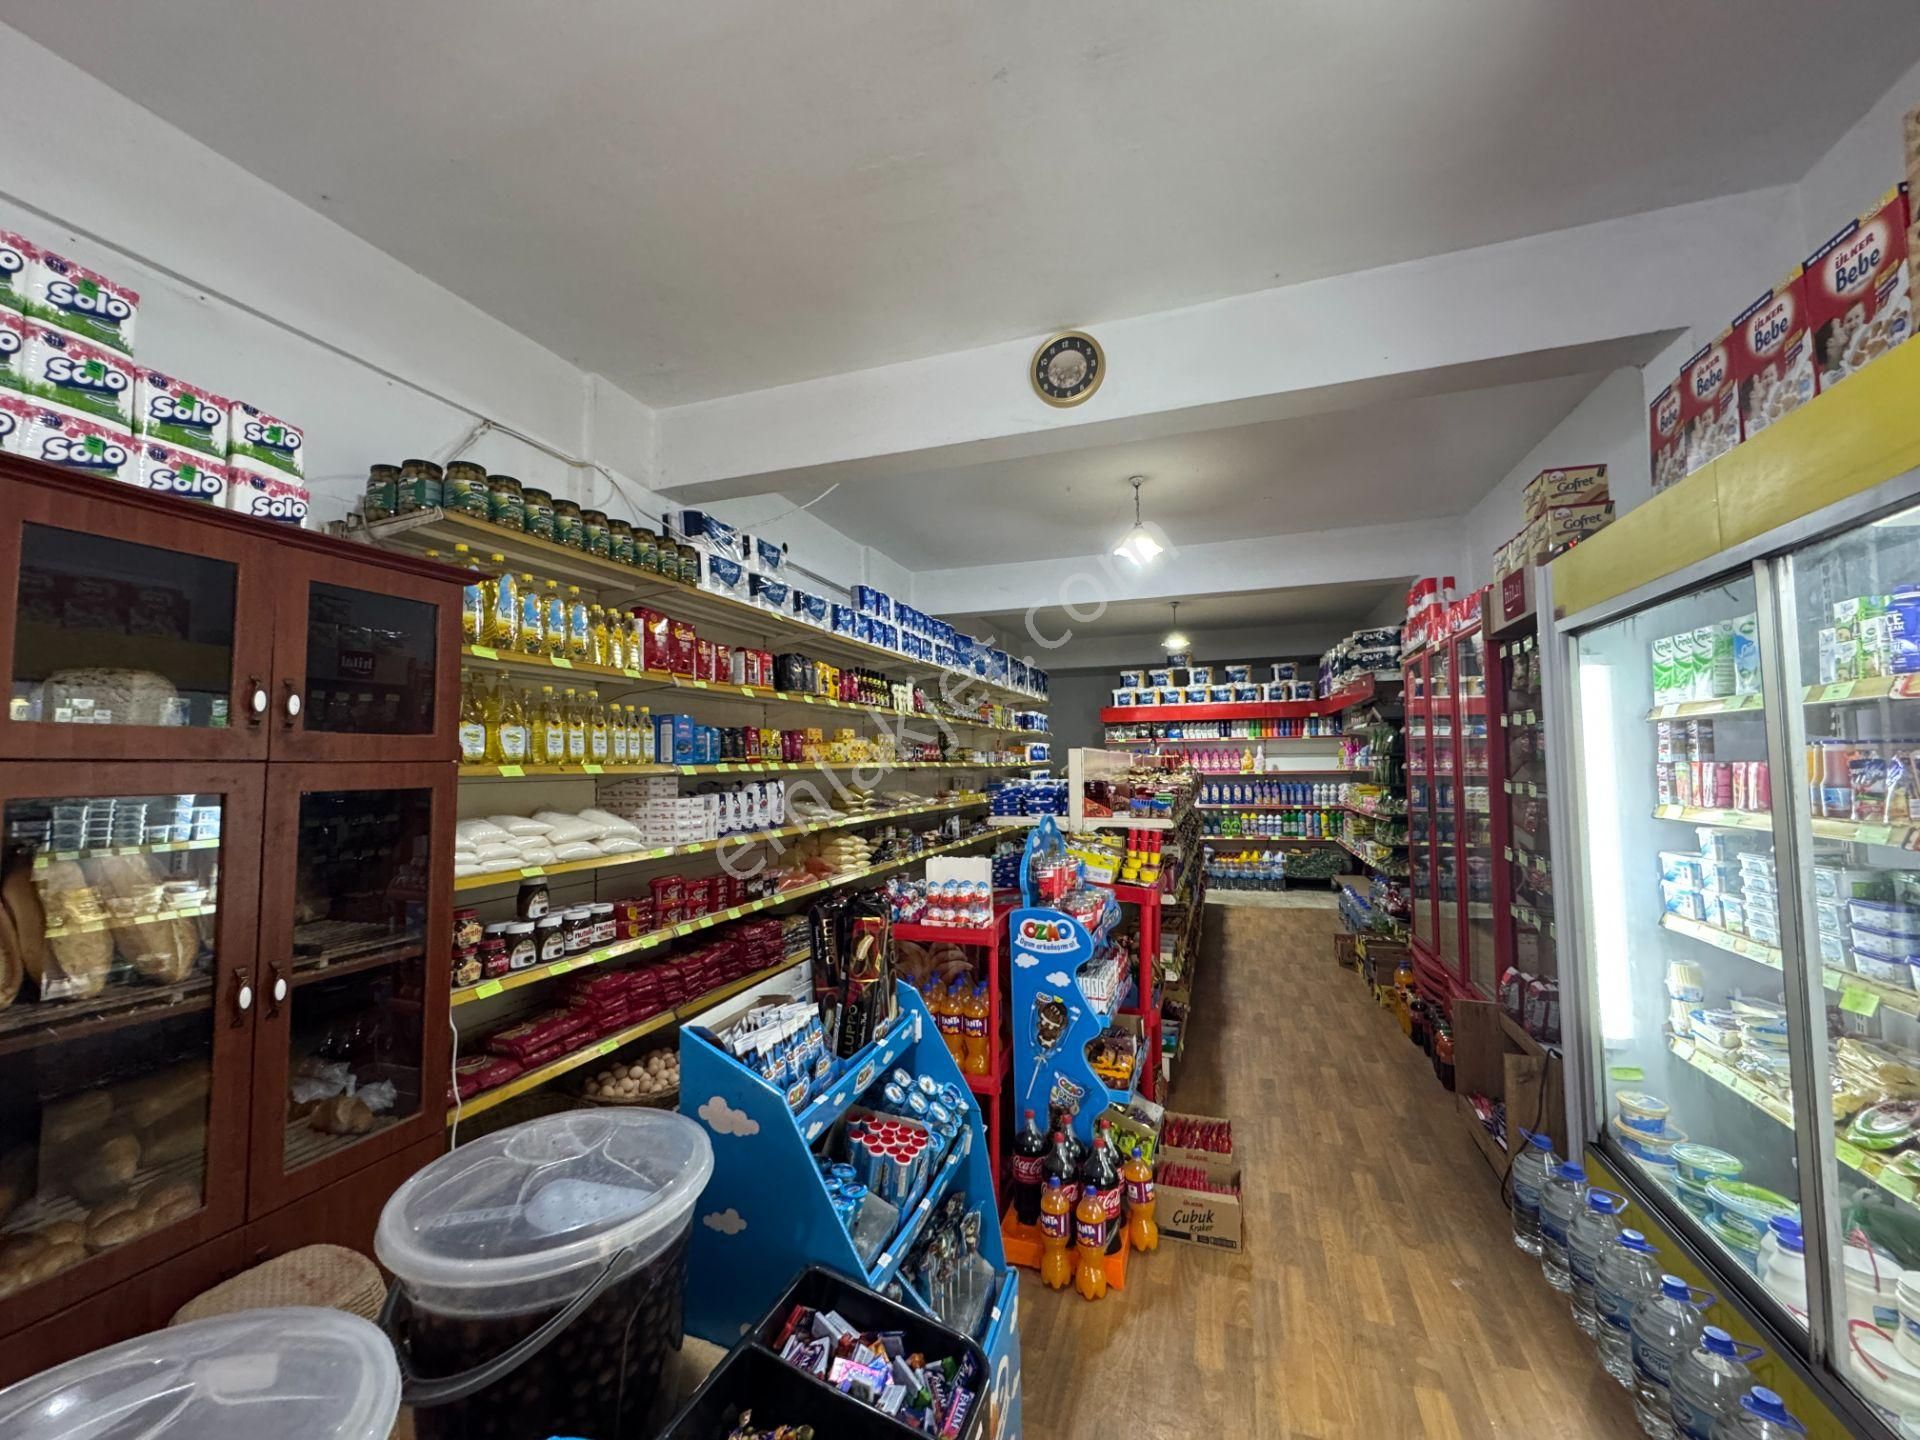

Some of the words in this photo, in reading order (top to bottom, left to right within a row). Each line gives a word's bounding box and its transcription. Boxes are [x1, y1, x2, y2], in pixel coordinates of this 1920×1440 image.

[1836, 248, 1880, 292] Bebe
[46, 281, 131, 320] Solo
[1755, 317, 1788, 352] Bebe
[1696, 368, 1722, 396] Bebe
[150, 396, 221, 427] Solo
[150, 469, 222, 497] Solo
[1557, 476, 1595, 493] Gofret
[251, 497, 307, 520] Solo
[1563, 514, 1602, 531] Gofret
[822, 918, 835, 965] LUPPO
[843, 1004, 858, 1055] LUPPO
[1173, 1209, 1215, 1226] Çubuk
[951, 1392, 971, 1429] FALIM
